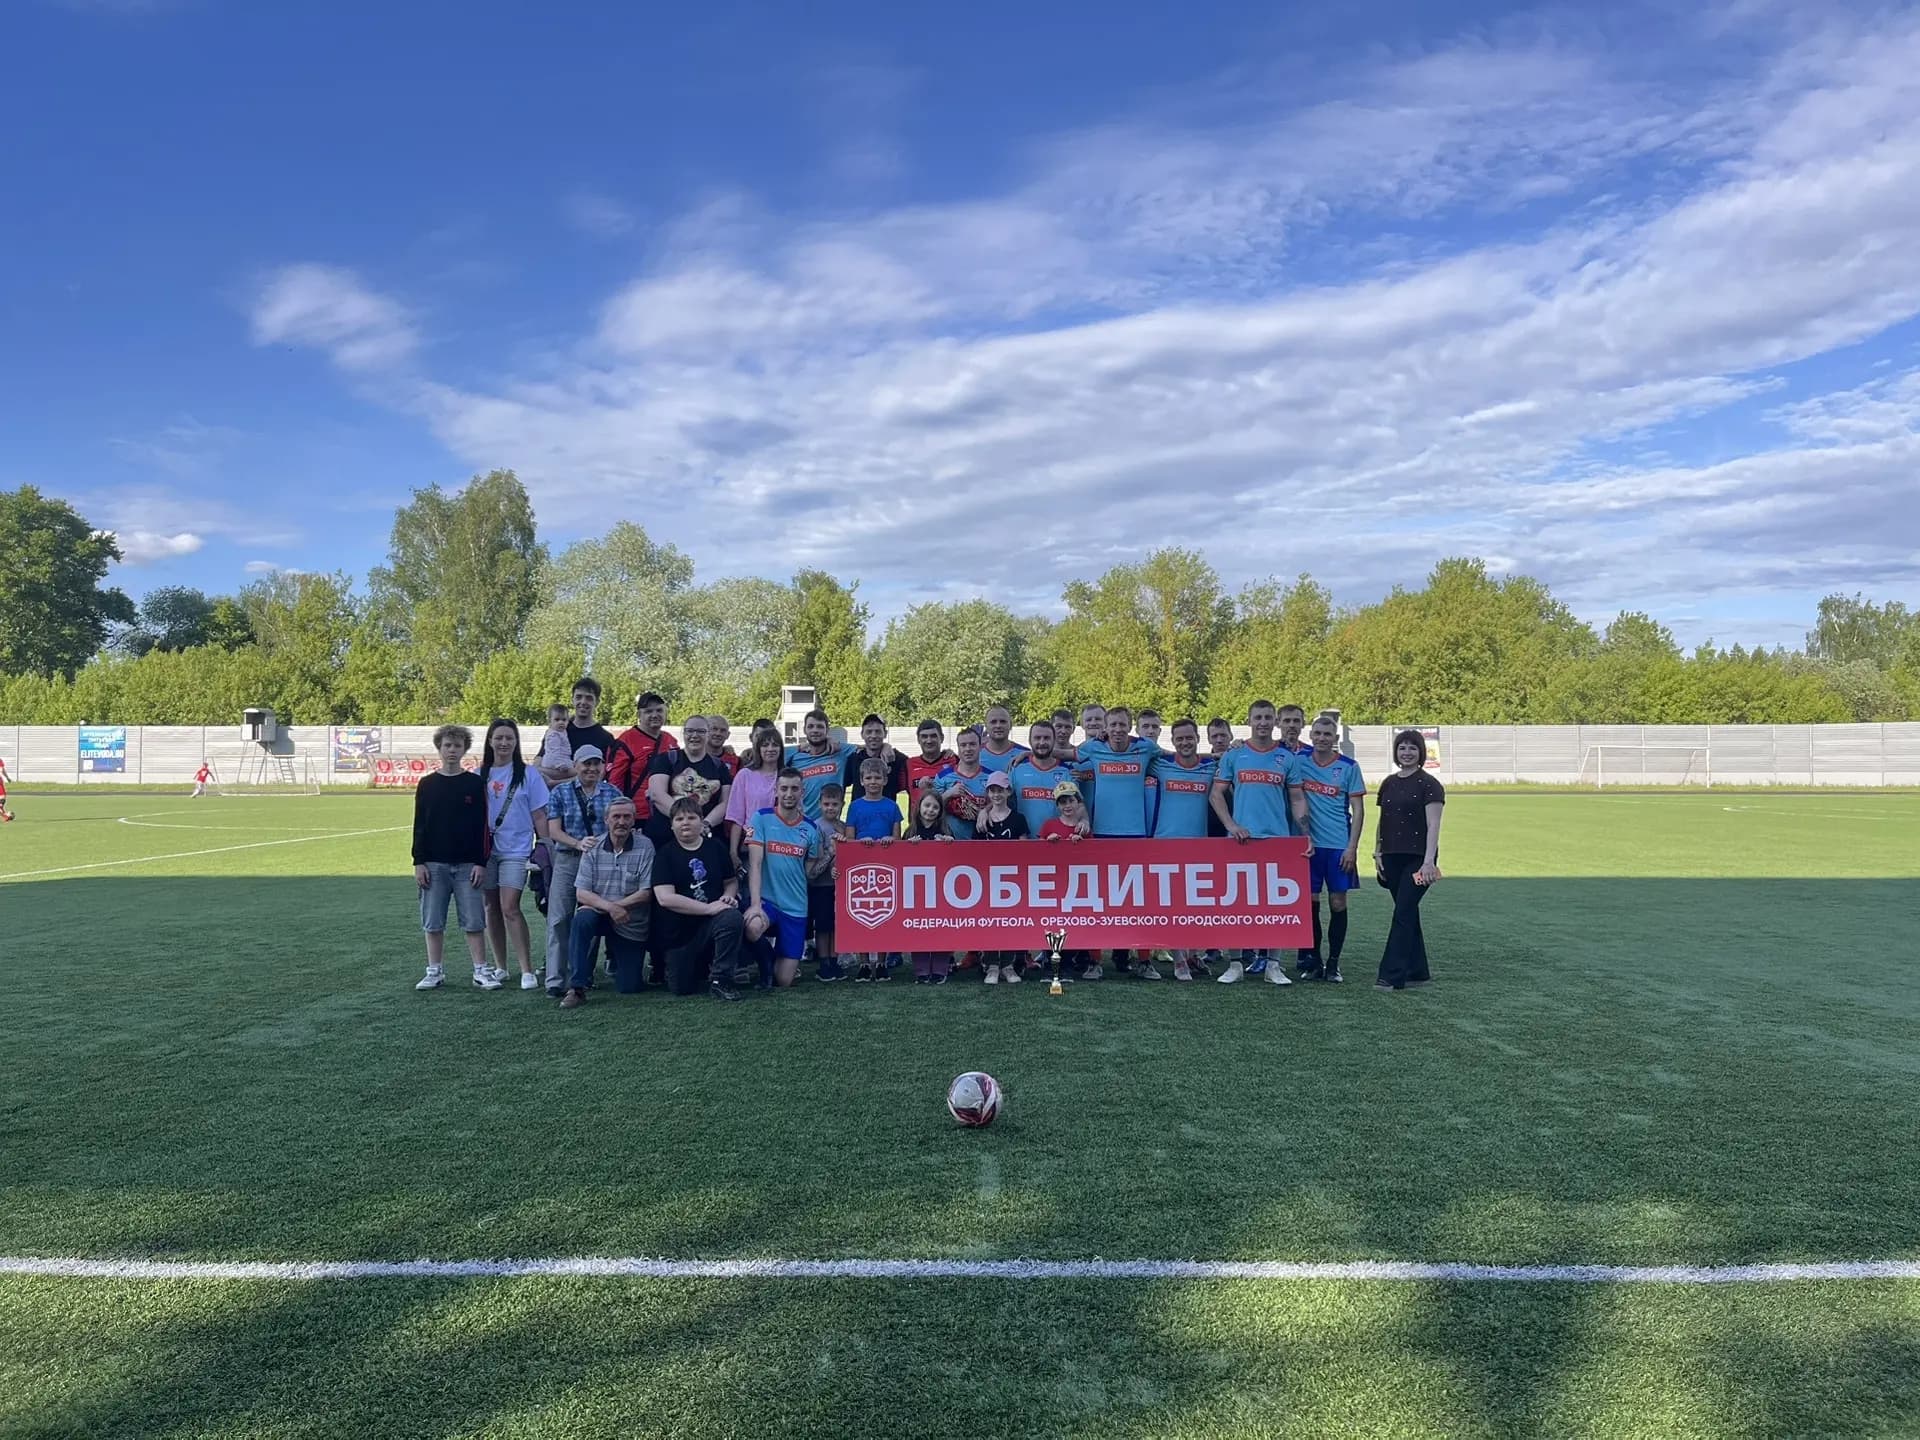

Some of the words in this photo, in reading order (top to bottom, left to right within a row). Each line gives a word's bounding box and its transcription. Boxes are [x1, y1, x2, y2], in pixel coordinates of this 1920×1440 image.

[821, 764, 834, 773] 3D
[1126, 764, 1138, 772] 3D
[1240, 771, 1265, 781] Твой
[1267, 773, 1281, 783] 3D
[1193, 783, 1206, 791] 3D
[1322, 786, 1336, 795] 3D
[793, 846, 804, 856] 3D
[902, 862, 1300, 913] ПОБЕДИТЕЛЬ
[902, 917, 976, 929] ФЕДЕРАЦИЯ
[977, 917, 1034, 928] ФУТБОЛА
[1040, 915, 1169, 927] ОРЕХОВО-ЗУЕВСКОГО
[1172, 914, 1253, 927] ГОРОДСКОГО
[1254, 914, 1301, 926] ОКРУГА
